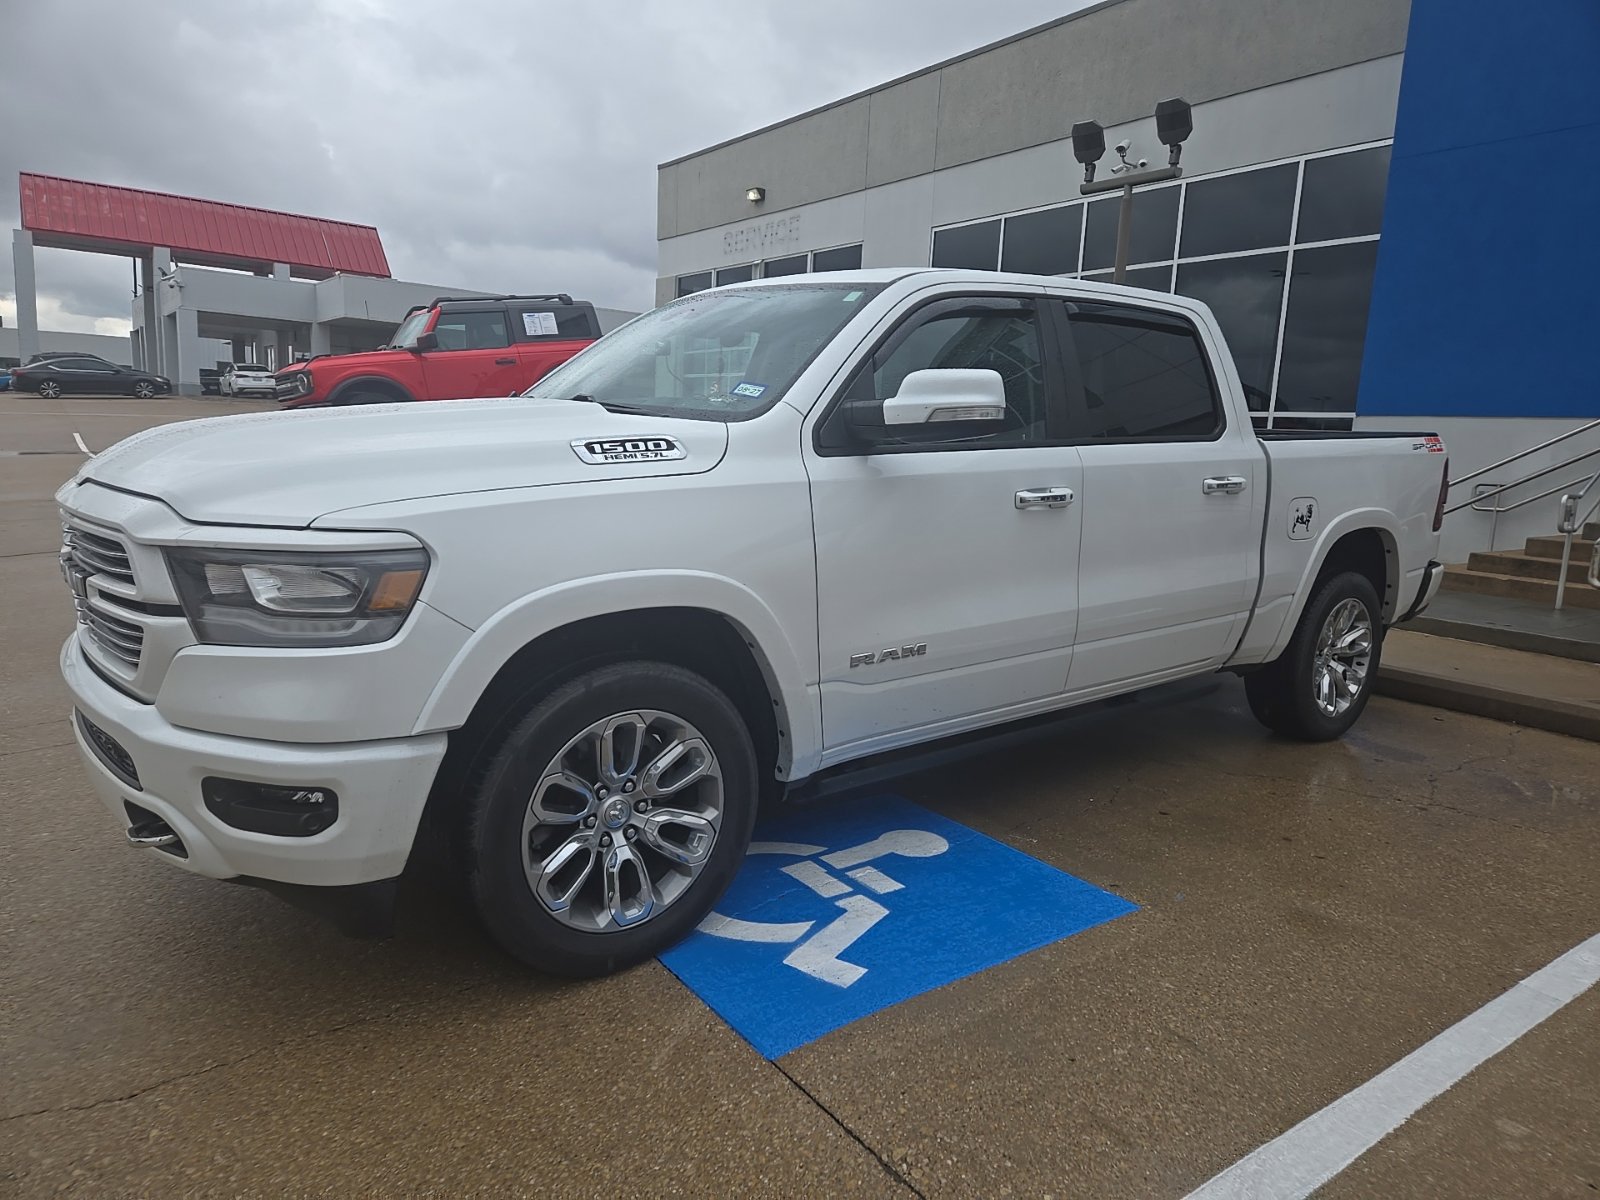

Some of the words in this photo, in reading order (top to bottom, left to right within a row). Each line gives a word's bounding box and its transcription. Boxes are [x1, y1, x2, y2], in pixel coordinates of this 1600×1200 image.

[590, 440, 668, 454] 1500
[1412, 442, 1444, 451] SPORT
[604, 453, 638, 461] HEMI
[849, 642, 927, 669] RAM
